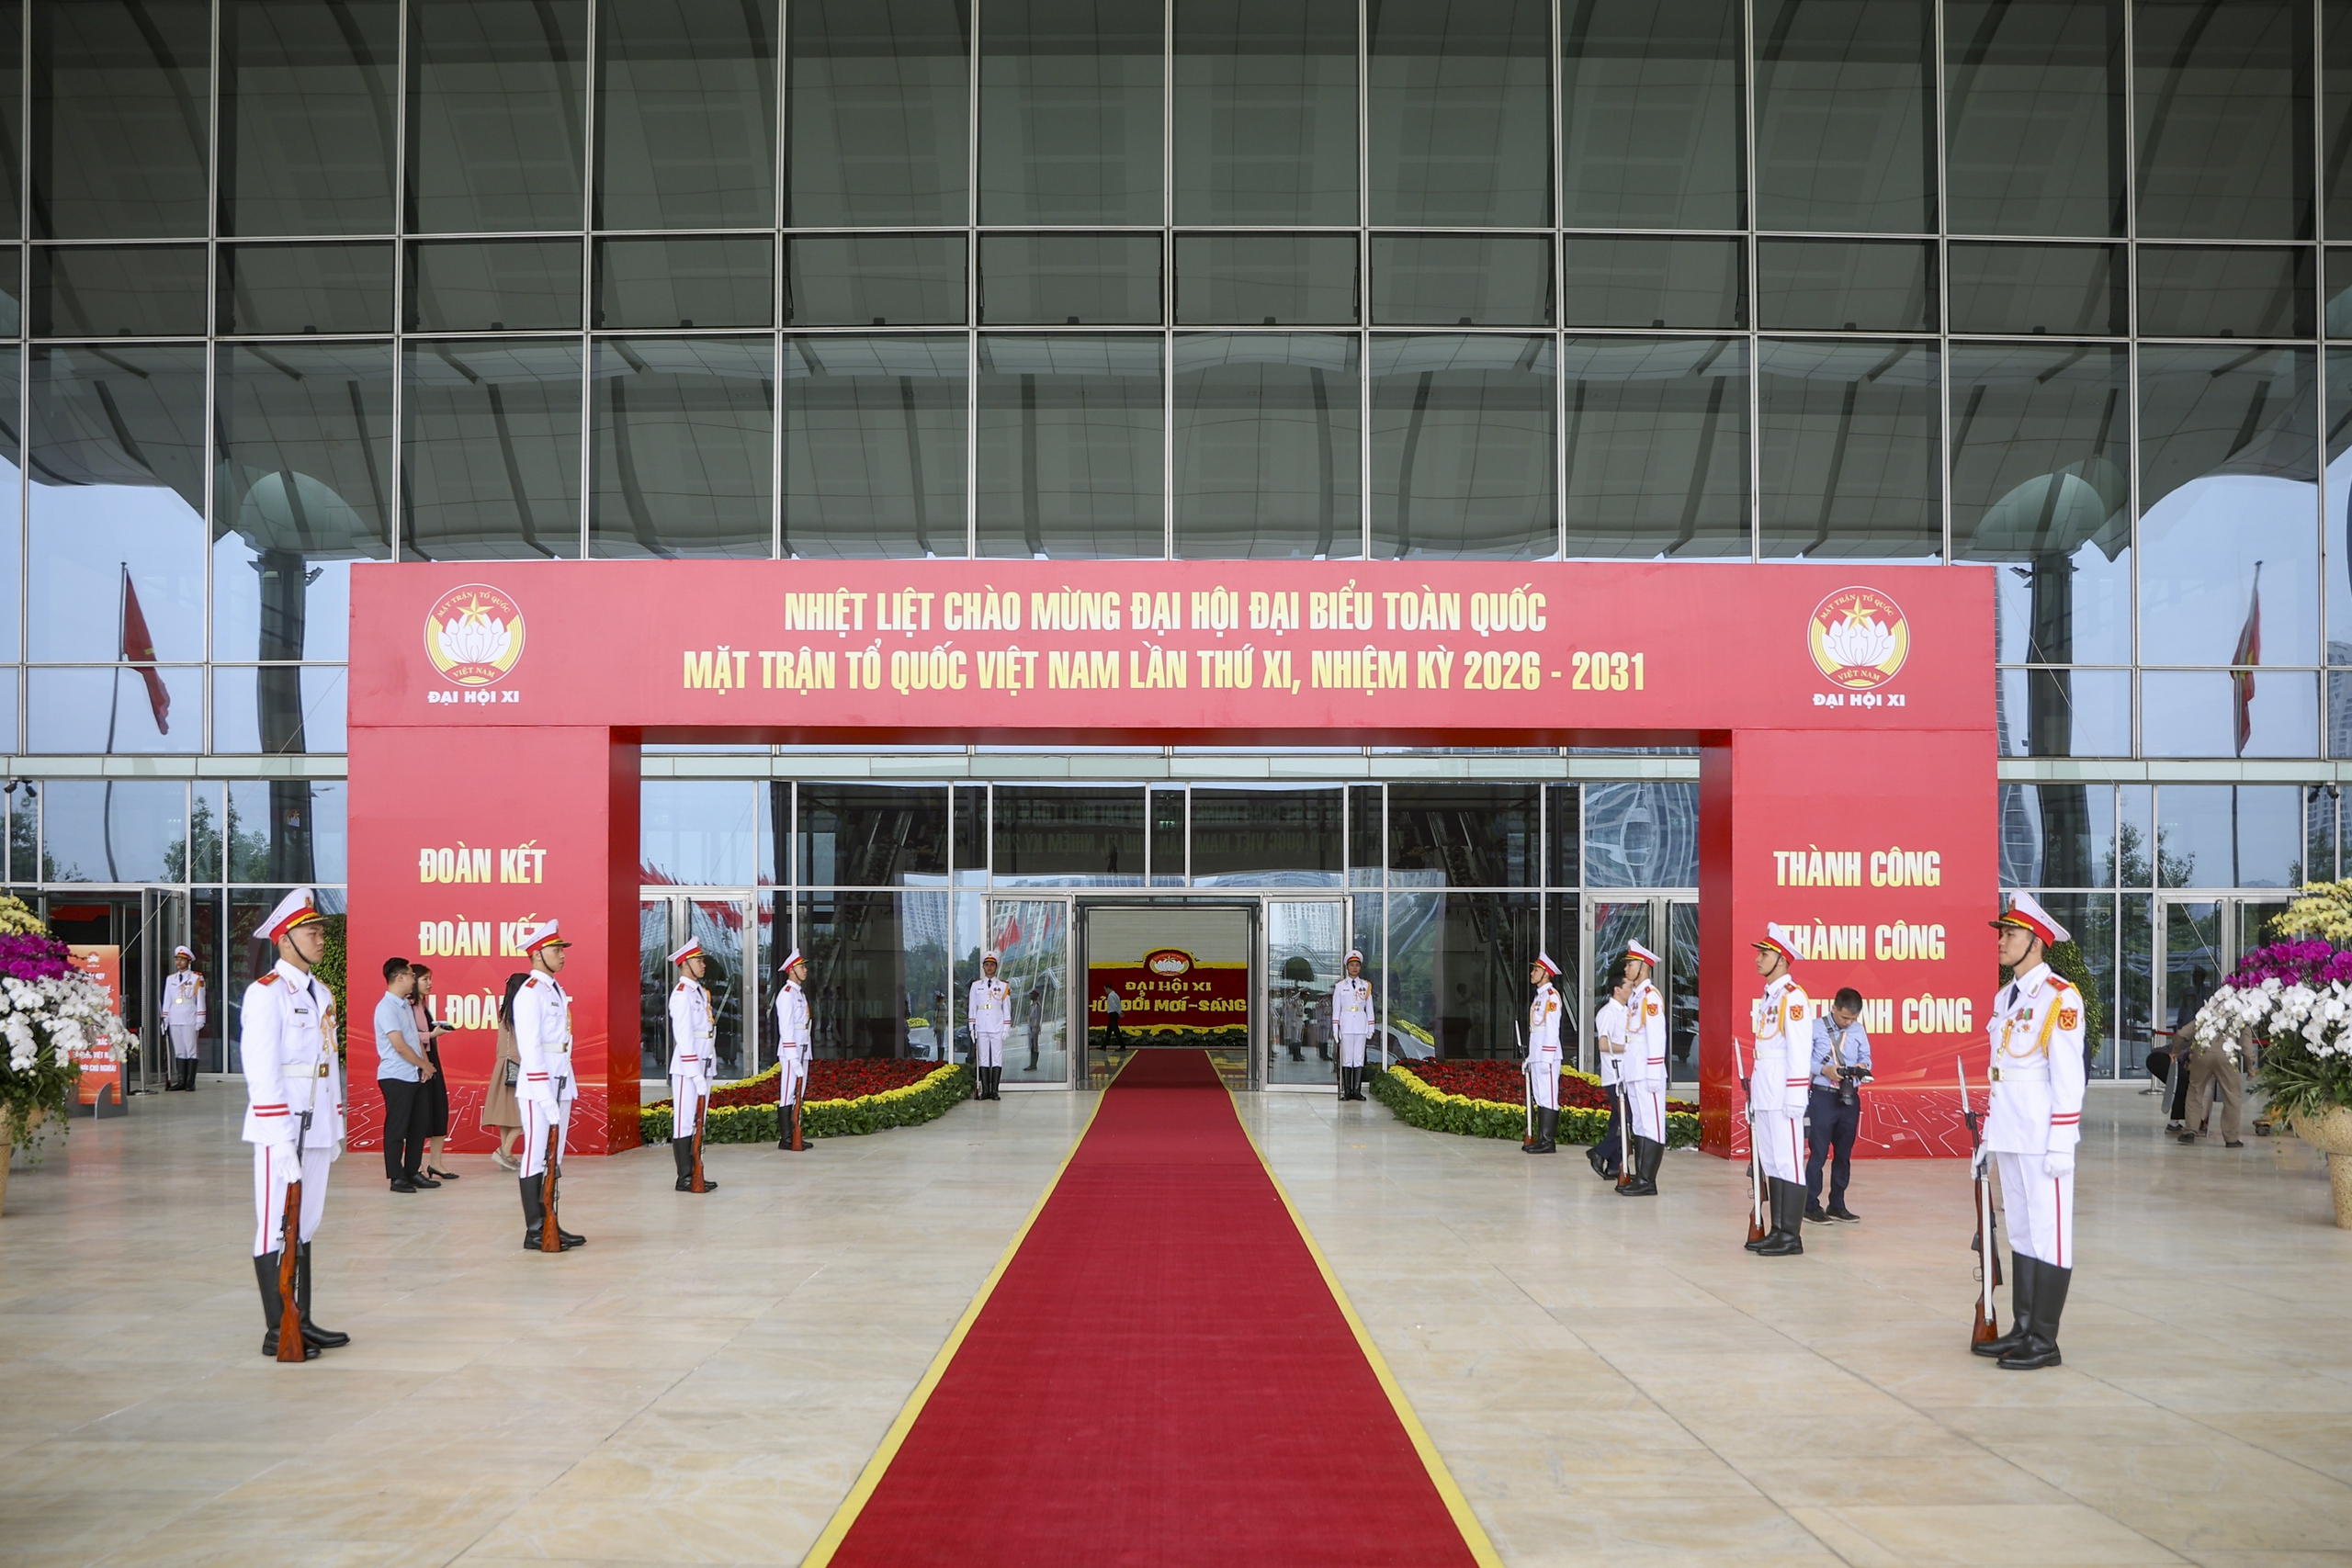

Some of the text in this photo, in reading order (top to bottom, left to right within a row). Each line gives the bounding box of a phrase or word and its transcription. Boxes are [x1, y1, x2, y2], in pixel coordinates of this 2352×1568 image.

[437, 602, 452, 617] MẶT
[451, 592, 473, 604] TRẬN
[491, 596, 511, 614] QUỐC
[785, 579, 1546, 637] NHIỆT LIỆT CHÀO MỪNG ĐẠI HỘI ĐẠI BIỂU TOÀN QUỐC
[1820, 604, 1835, 620] MẶT
[1834, 594, 1856, 606] TRẬN
[1874, 599, 1894, 616] QUỐC
[452, 666, 496, 678] VIỆT NAM
[684, 645, 751, 695] MẶT
[758, 645, 836, 695] TRẬN
[844, 637, 882, 690] TỔ
[890, 640, 967, 695] QUỐC
[976, 645, 1039, 696] VIỆT
[1048, 650, 1120, 689] NAM
[1130, 640, 1187, 689] LẦN
[1196, 643, 1254, 689] THỨ
[1261, 649, 1301, 695] XI,
[1311, 644, 1408, 696] NHIỆM
[1417, 644, 1454, 689] KỲ
[1464, 650, 1541, 691] 2026
[1572, 651, 1644, 691] 2031
[1838, 670, 1881, 682] VIỆT NAM
[427, 688, 520, 706] ĐẠI HỘI XI
[1813, 691, 1905, 709] ĐẠI HỘI XI
[418, 839, 548, 884] ĐOÀN KẾT
[1772, 843, 1941, 887] THÀNH CÔNG
[418, 913, 492, 957] ĐOÀN
[1874, 919, 1946, 961] CÔNG
[1125, 977, 1212, 994] ĐẠI HỘI XI
[445, 987, 503, 1031] ĐOÀ
[1810, 998, 1893, 1034] TNH
[1902, 992, 1973, 1034] CÔNG
